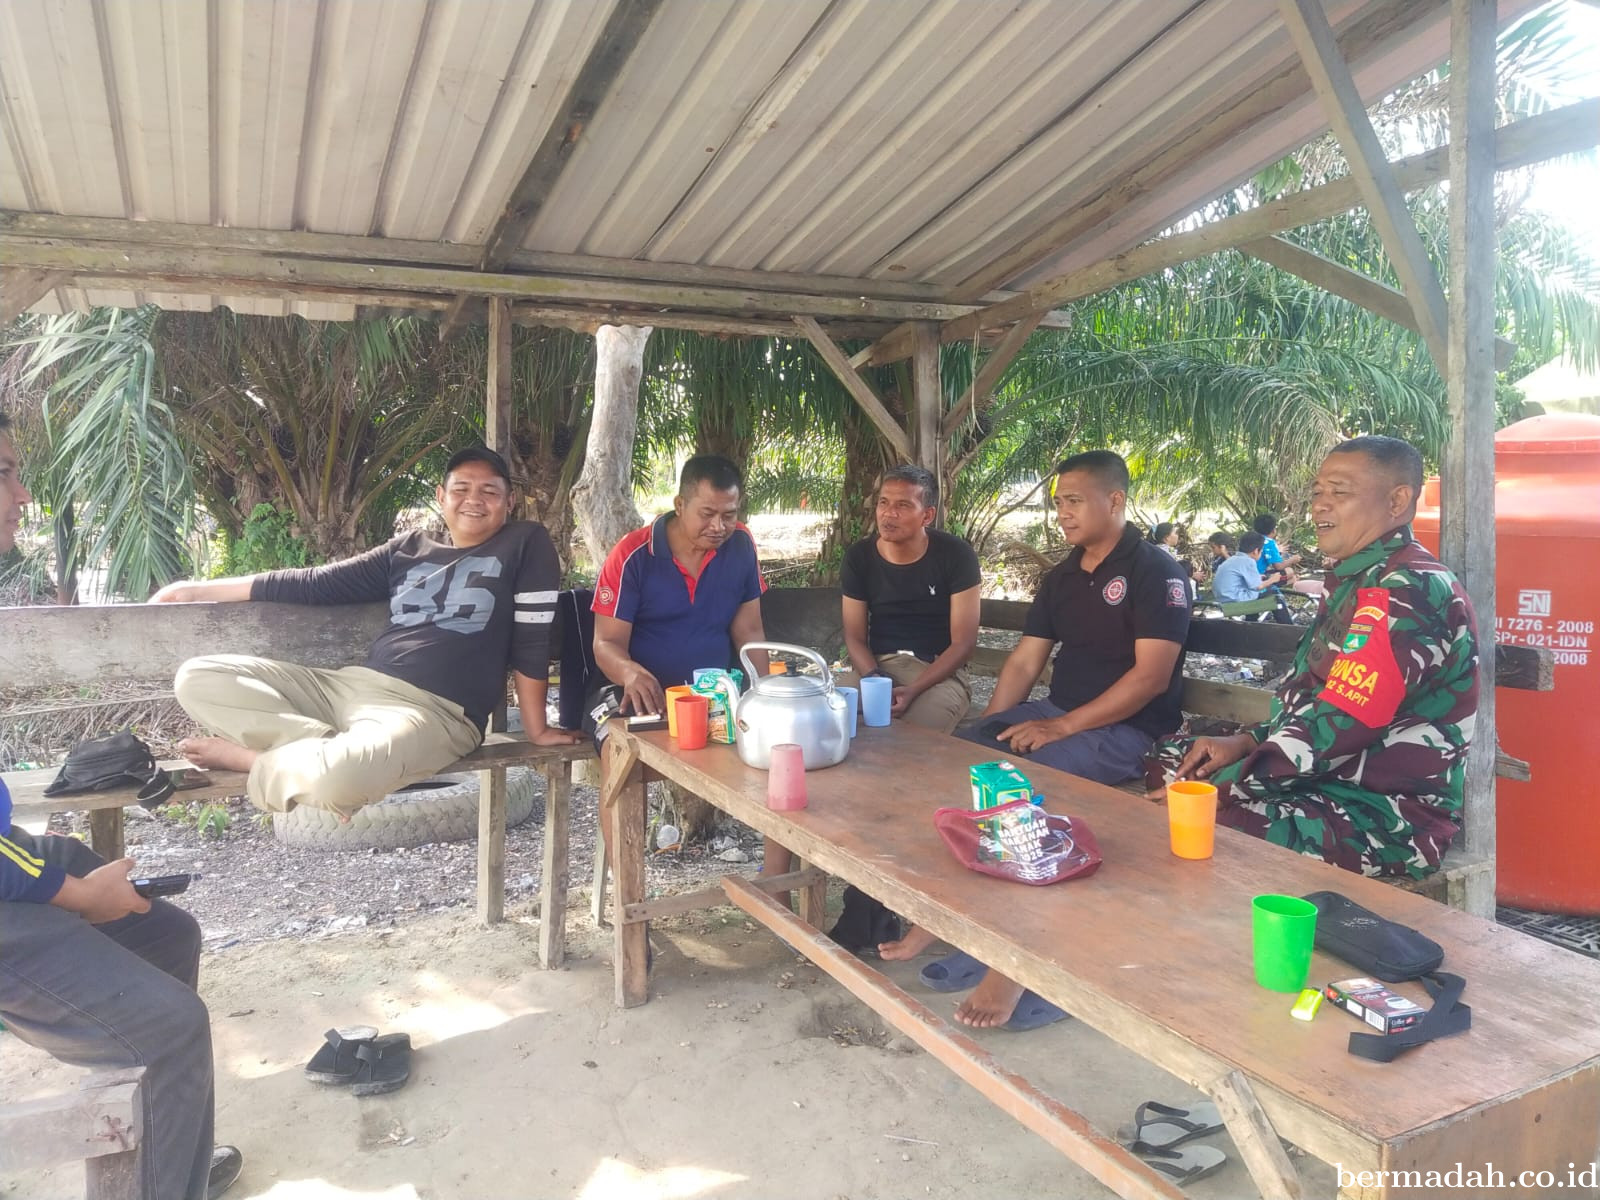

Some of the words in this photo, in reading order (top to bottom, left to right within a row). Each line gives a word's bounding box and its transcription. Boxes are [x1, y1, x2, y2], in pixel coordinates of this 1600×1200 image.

[390, 556, 503, 635] 86
[1517, 589, 1552, 617] SNI
[1507, 617, 1543, 631] 7276
[1556, 620, 1594, 634] 2008
[1553, 651, 1588, 665] 2008
